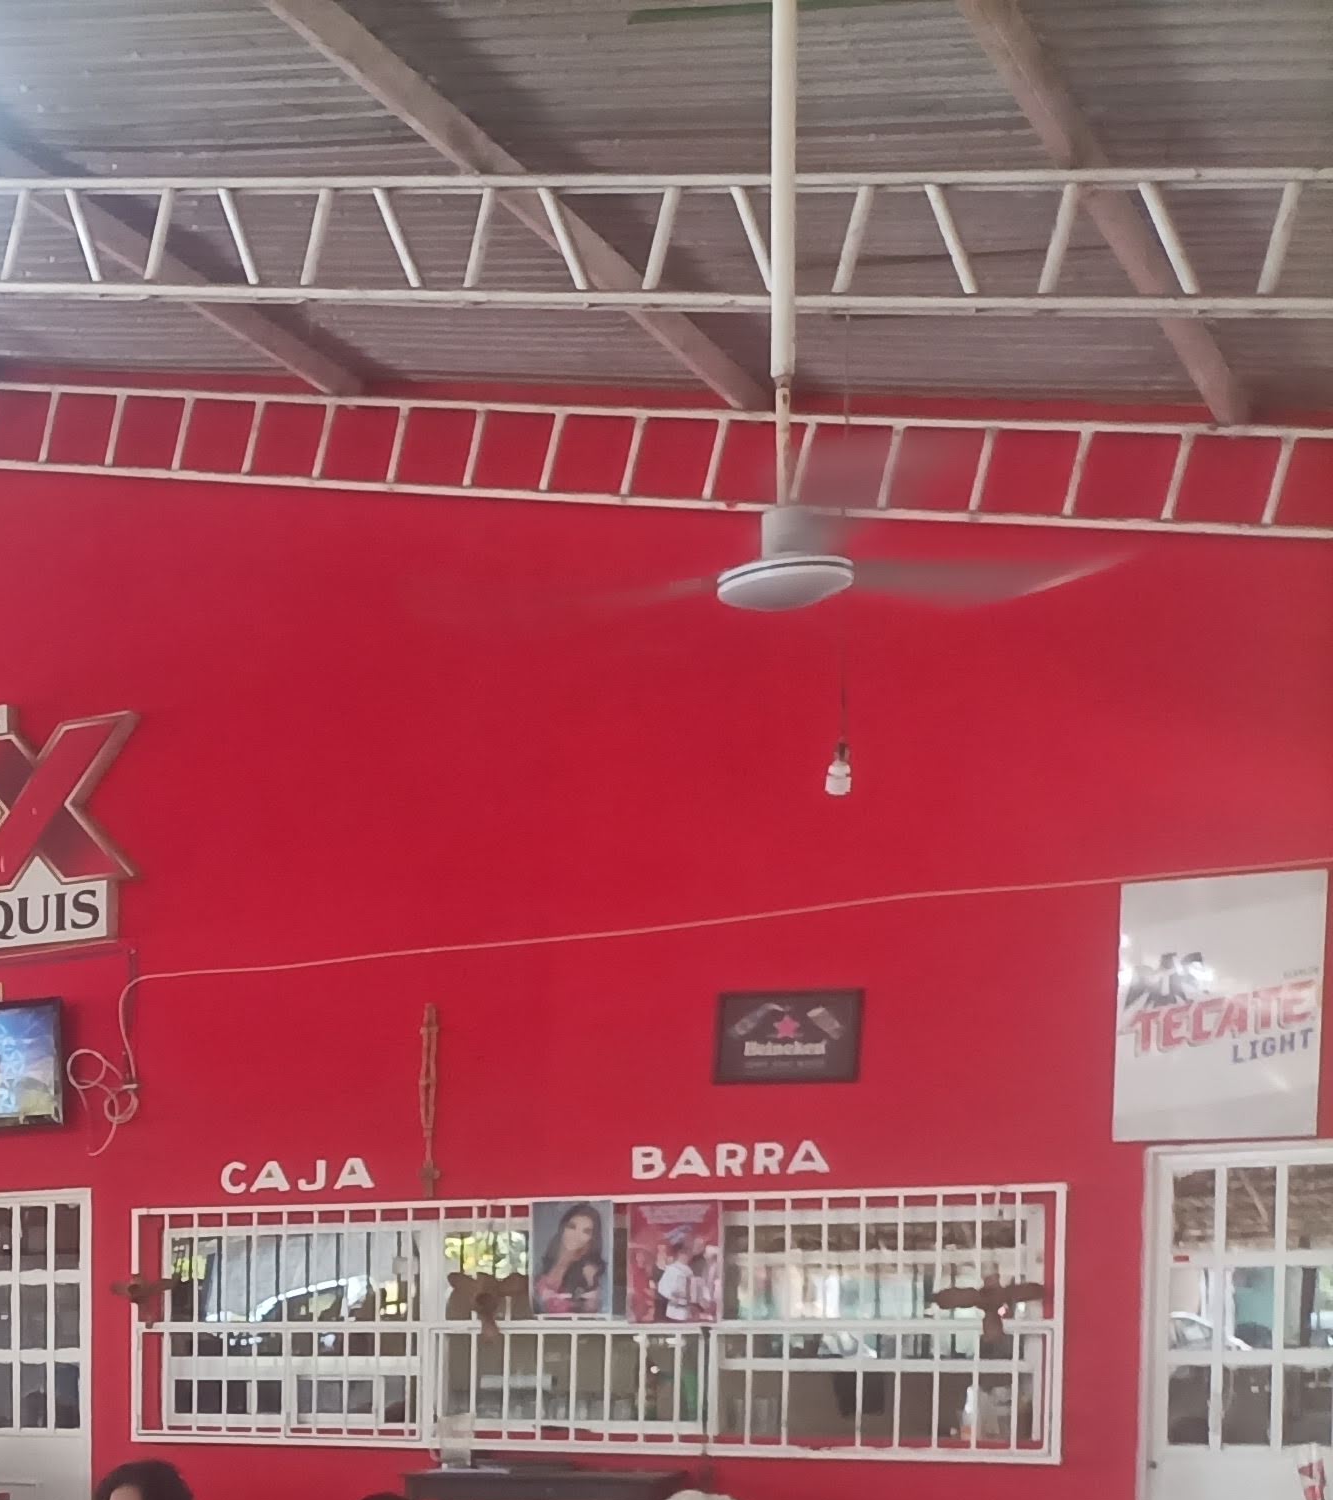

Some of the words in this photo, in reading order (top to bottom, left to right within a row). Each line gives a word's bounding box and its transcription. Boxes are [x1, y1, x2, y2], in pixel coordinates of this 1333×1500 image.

[1132, 979, 1318, 1056] TECATE
[1232, 1028, 1315, 1064] LIGHT
[220, 1157, 375, 1194] CAJA
[631, 1139, 831, 1180] BARRA
